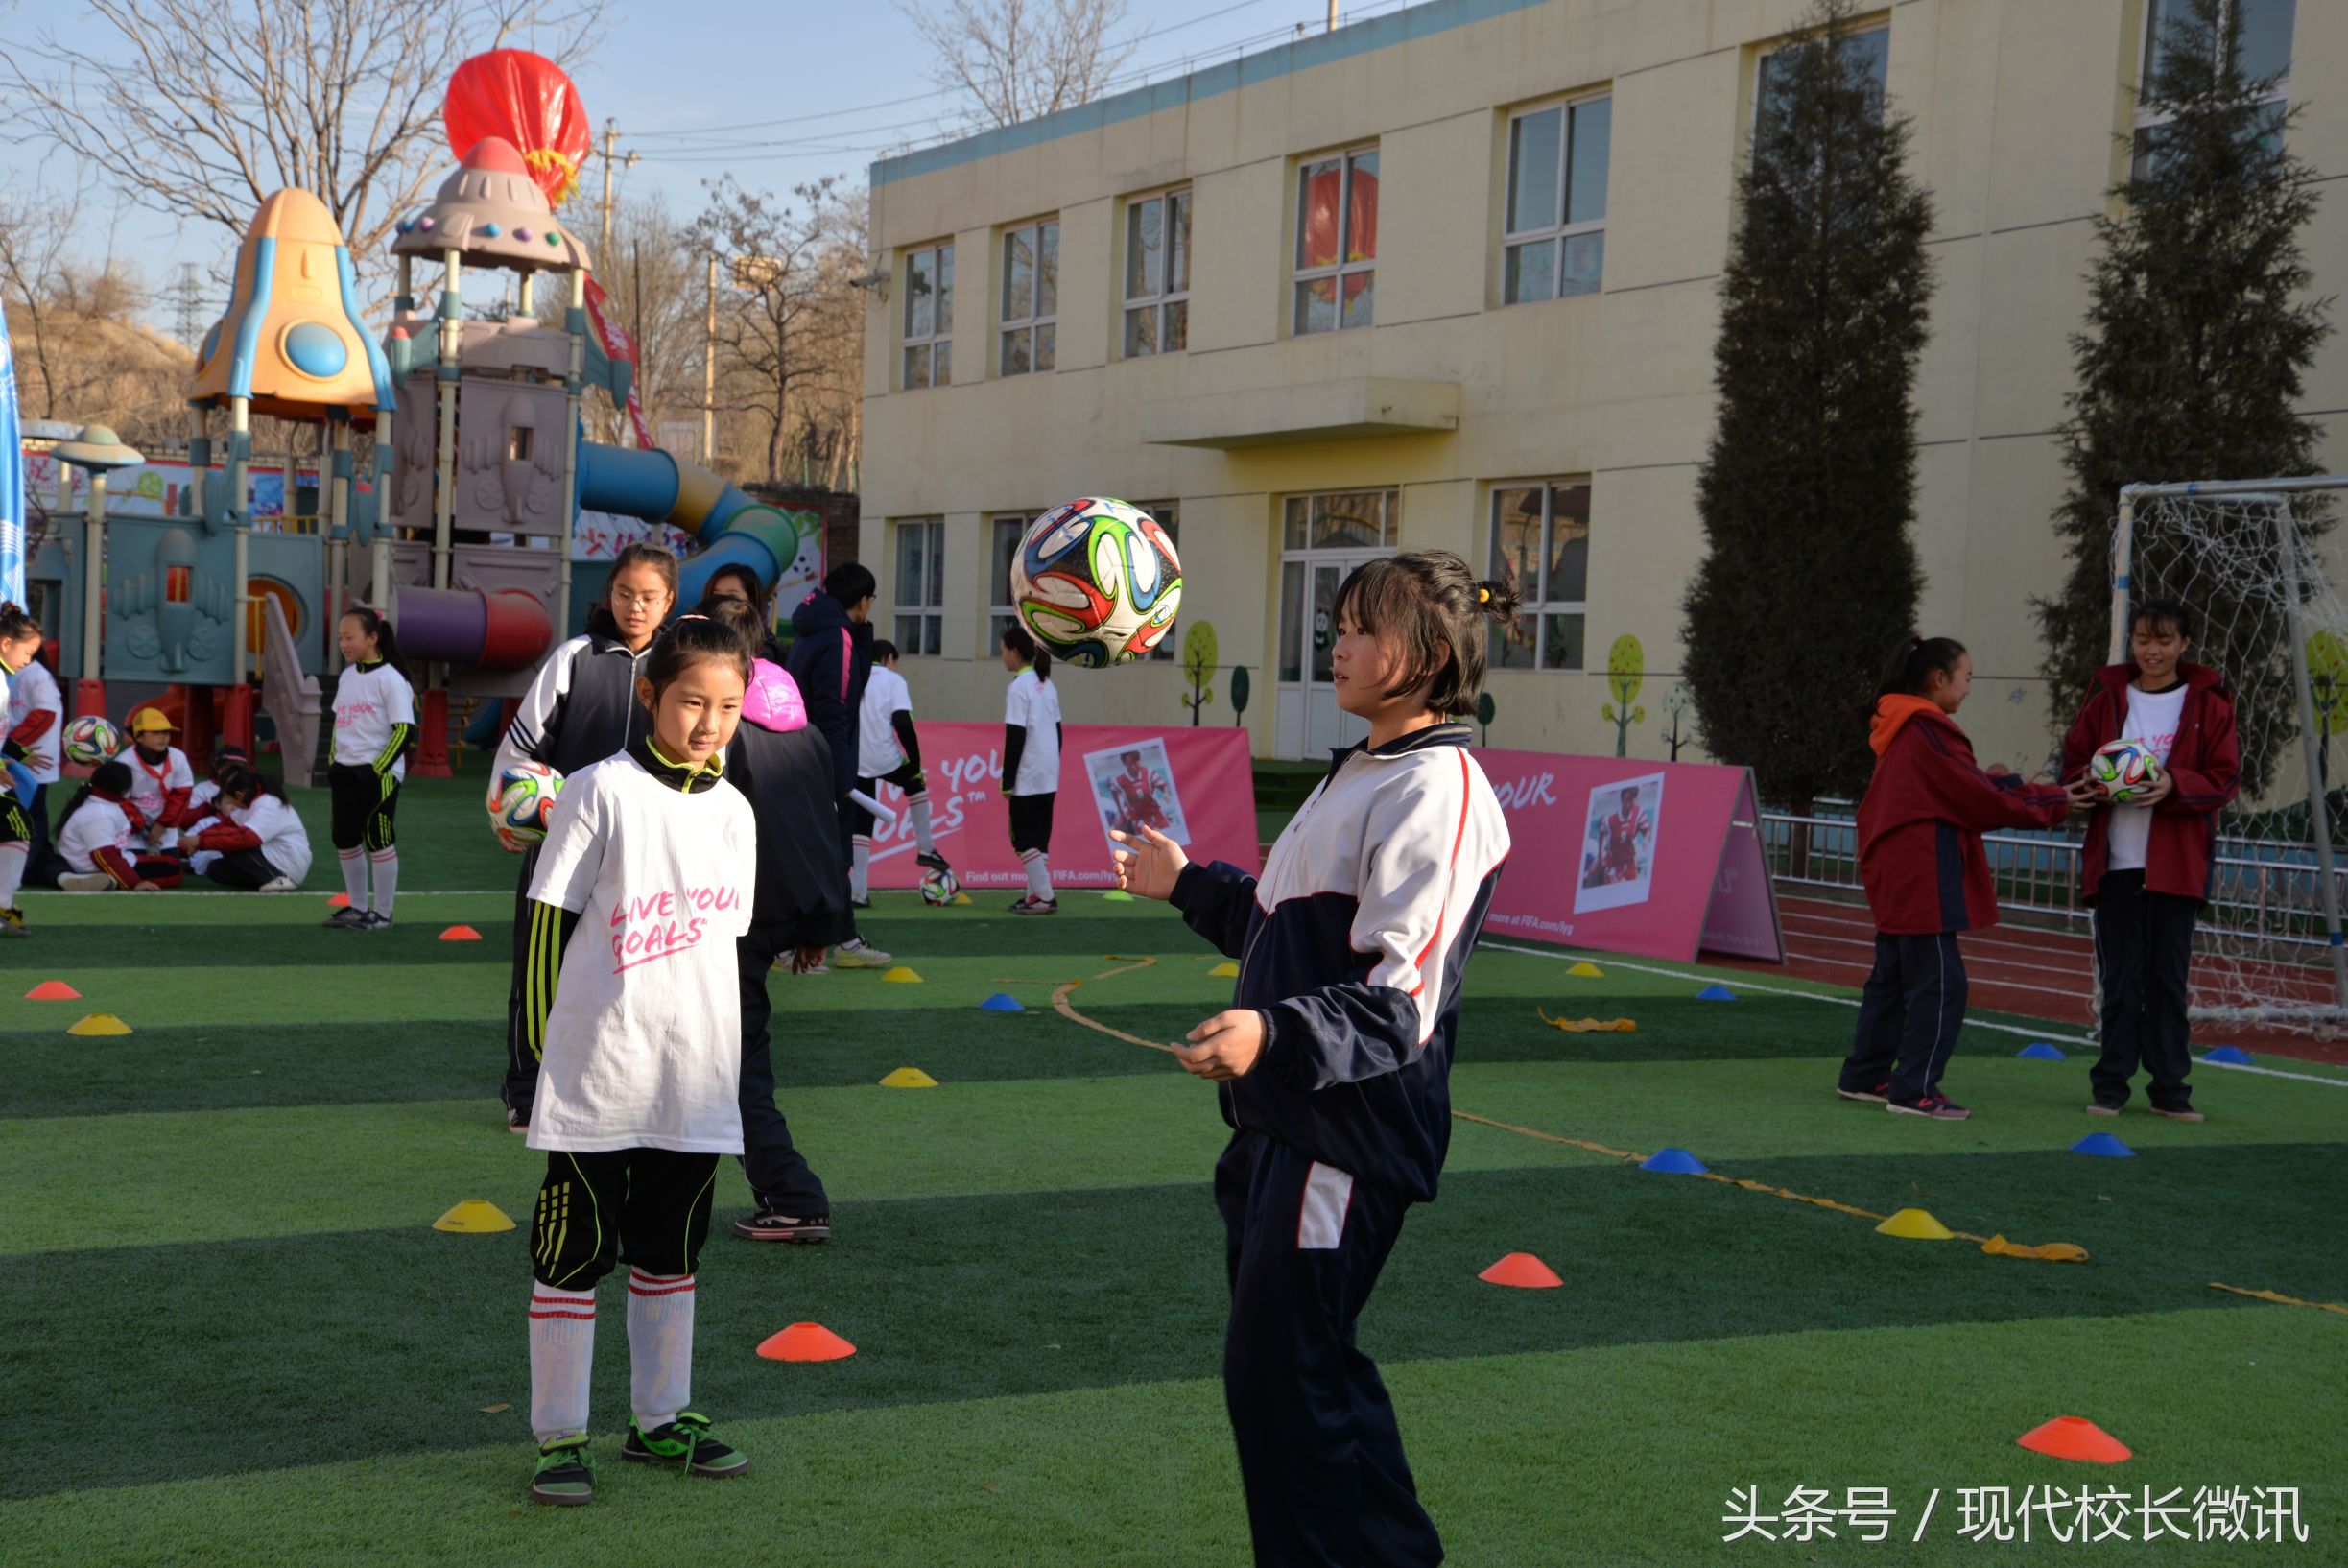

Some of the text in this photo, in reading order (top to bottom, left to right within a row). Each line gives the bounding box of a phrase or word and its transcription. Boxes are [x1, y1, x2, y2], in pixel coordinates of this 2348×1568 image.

[941, 748, 1003, 793] YOU
[1493, 772, 1557, 810] OUR
[965, 870, 989, 882] Find
[991, 871, 1008, 882] out
[1011, 872, 1028, 882] mo
[610, 891, 675, 927] LIVE
